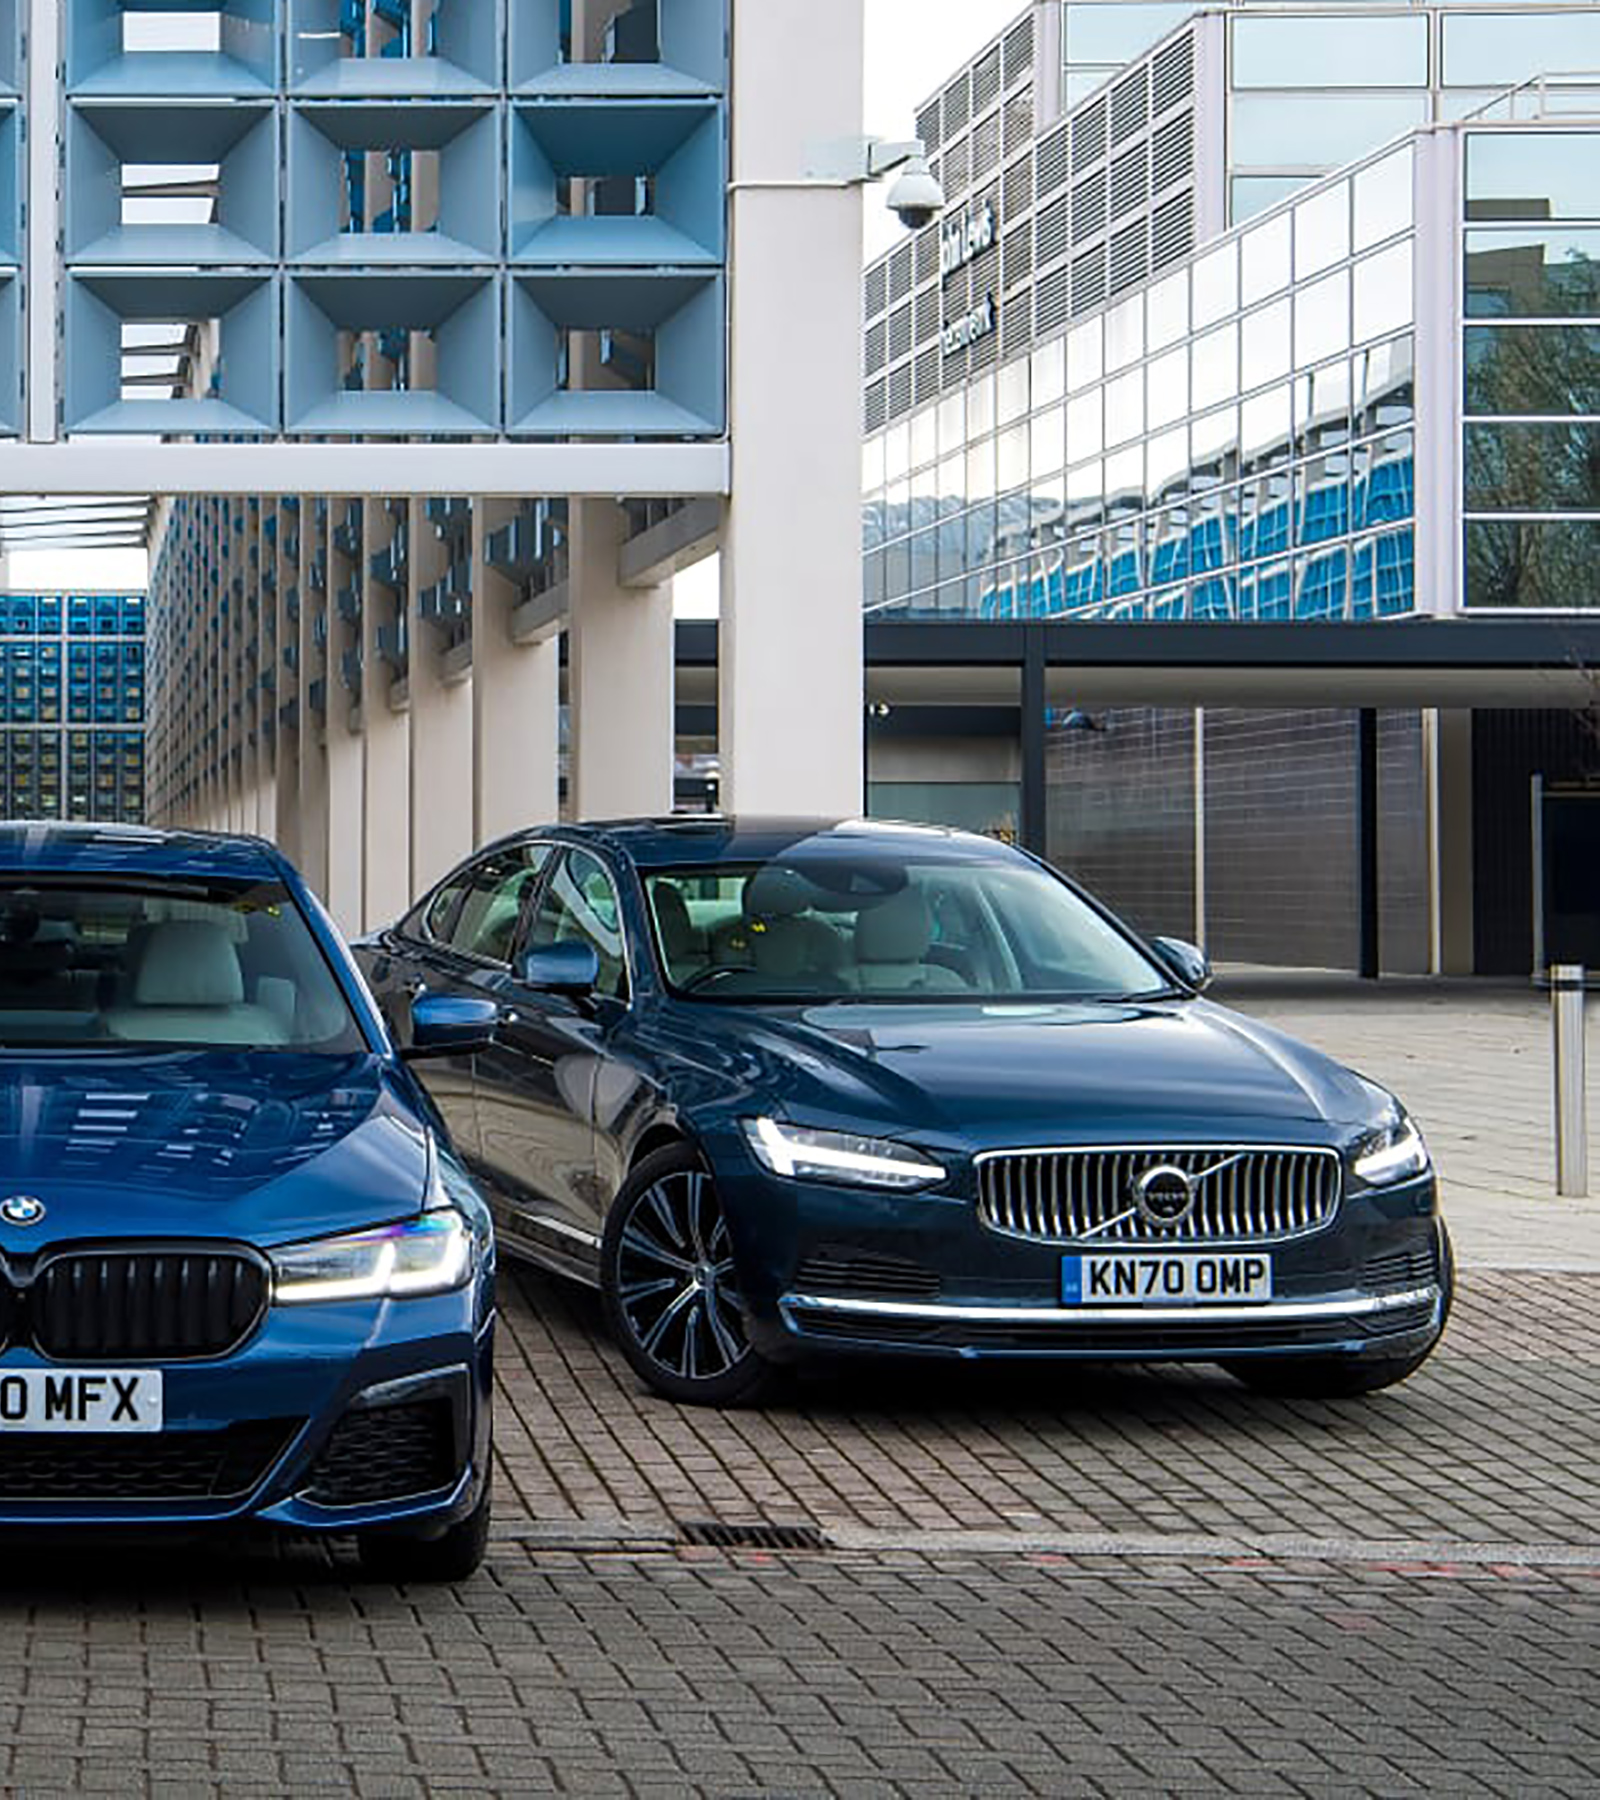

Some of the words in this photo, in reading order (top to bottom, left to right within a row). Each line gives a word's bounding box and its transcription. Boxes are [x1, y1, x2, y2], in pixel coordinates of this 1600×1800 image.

[1090, 1259, 1184, 1295] KN70
[1196, 1259, 1265, 1294] OMP
[44, 1375, 140, 1422] MFX
